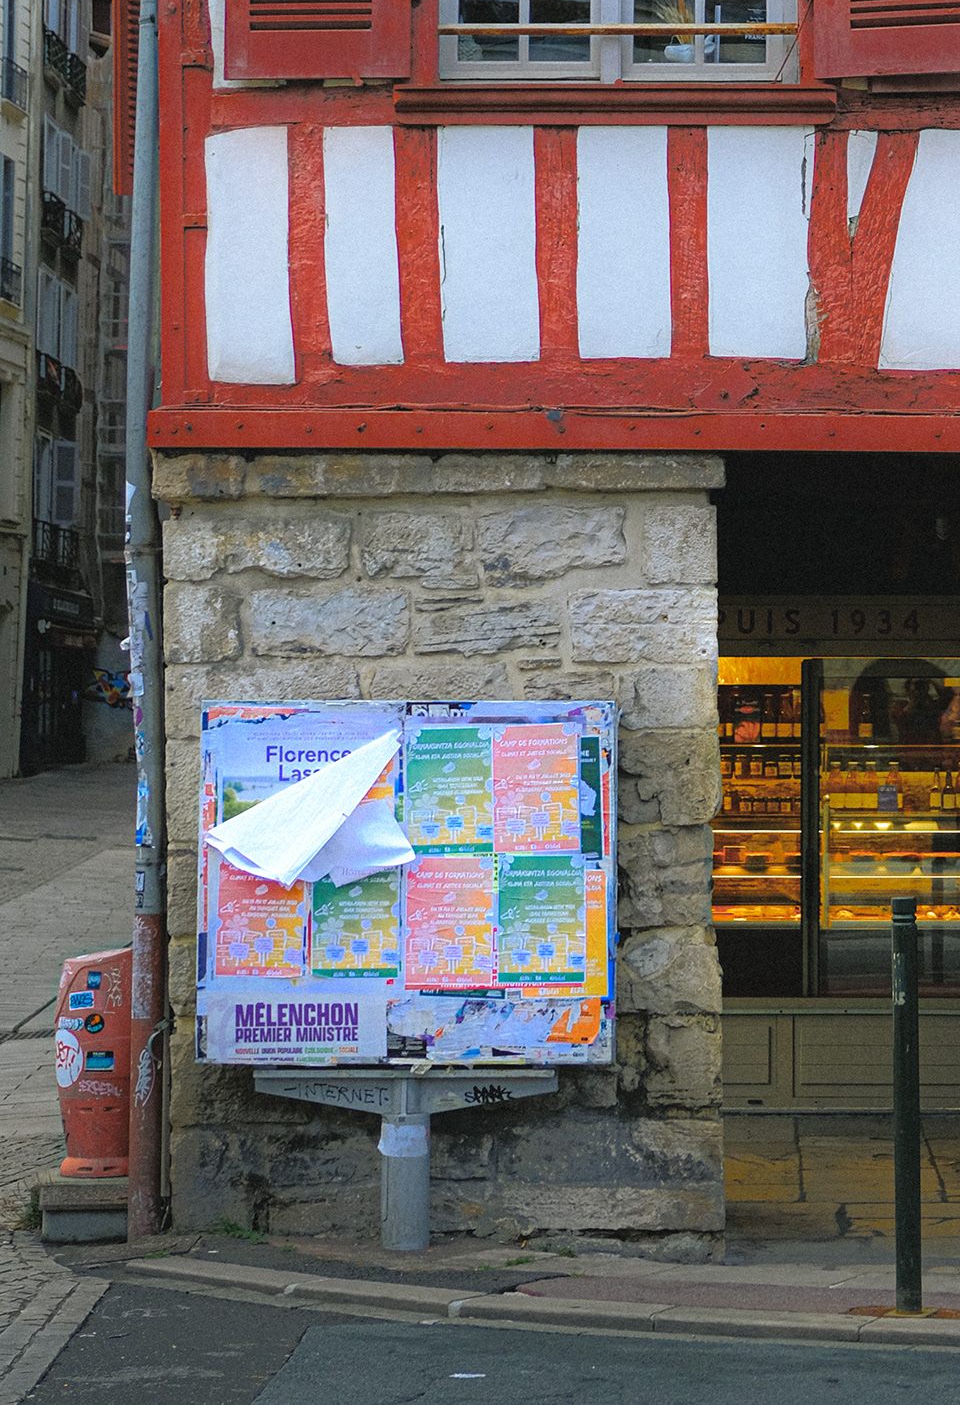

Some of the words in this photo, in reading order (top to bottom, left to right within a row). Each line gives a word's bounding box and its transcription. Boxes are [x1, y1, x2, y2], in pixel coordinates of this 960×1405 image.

[829, 608, 922, 635] 1934
[266, 746, 351, 763] Florence
[235, 1002, 359, 1027] MÉLENCHON
[235, 1027, 291, 1043] PREMIER
[296, 1026, 359, 1042] MINISTRE
[277, 1047, 303, 1055] POPULAIRE
[304, 1046, 334, 1054] ÉCOLOGIQUE
[339, 1046, 359, 1054] SOCIALE
